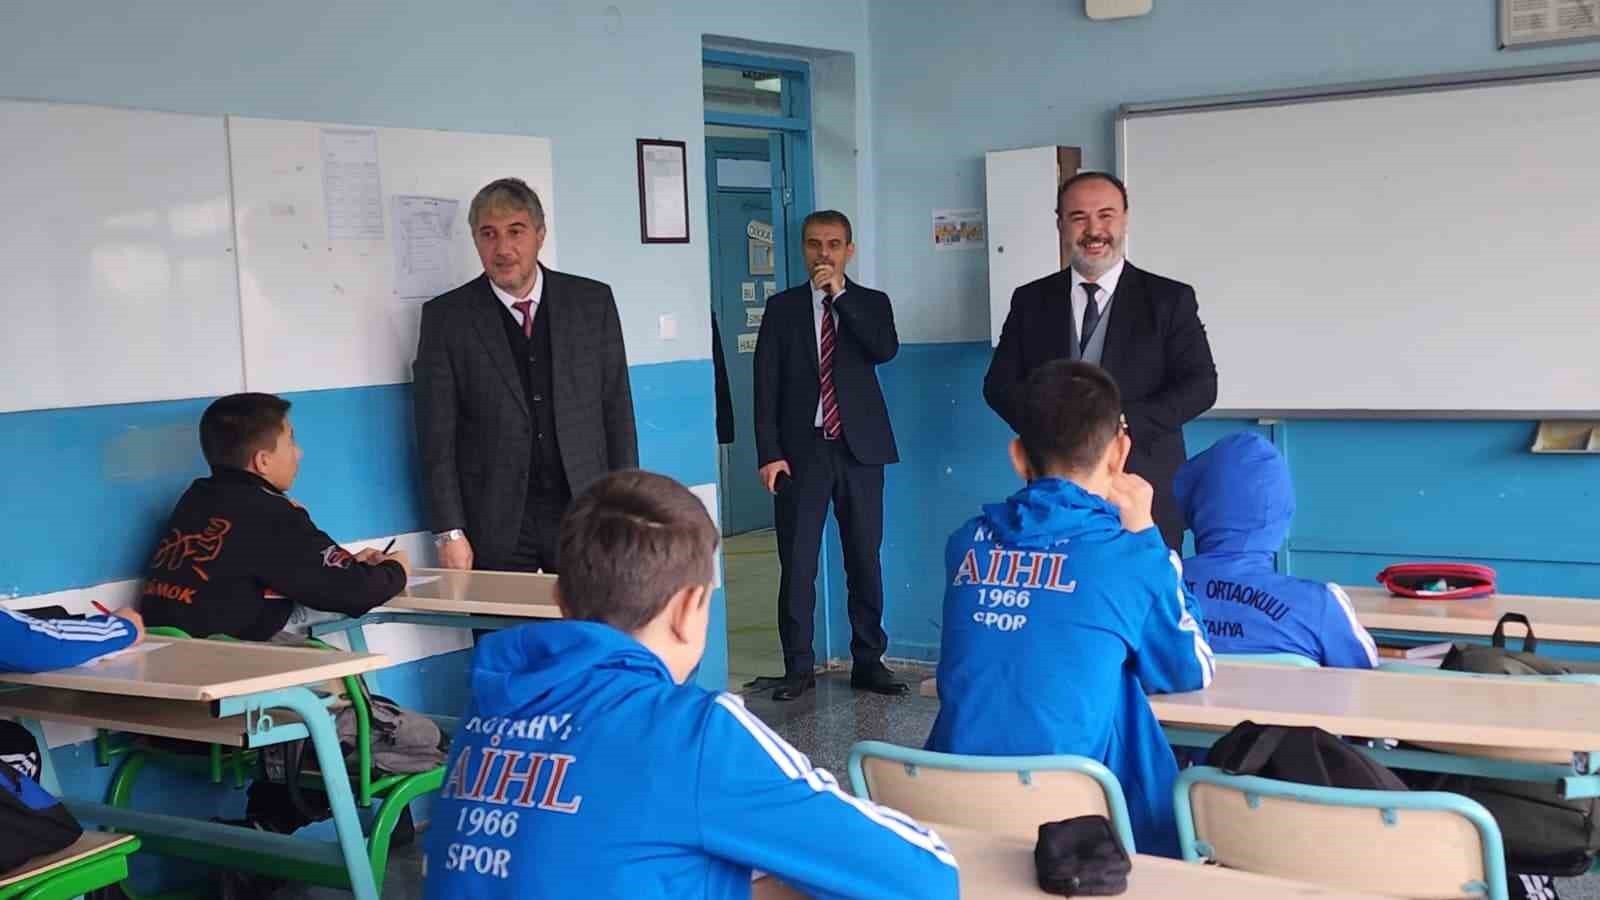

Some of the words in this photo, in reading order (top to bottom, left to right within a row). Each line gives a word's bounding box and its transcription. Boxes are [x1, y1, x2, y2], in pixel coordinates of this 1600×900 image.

[952, 543, 1077, 593] AİHL
[978, 588, 1031, 608] 1966
[1206, 579, 1290, 621] ORTAOKULU
[441, 735, 583, 814] AİHL
[457, 807, 519, 838] 1966
[446, 843, 511, 879] SPOR
